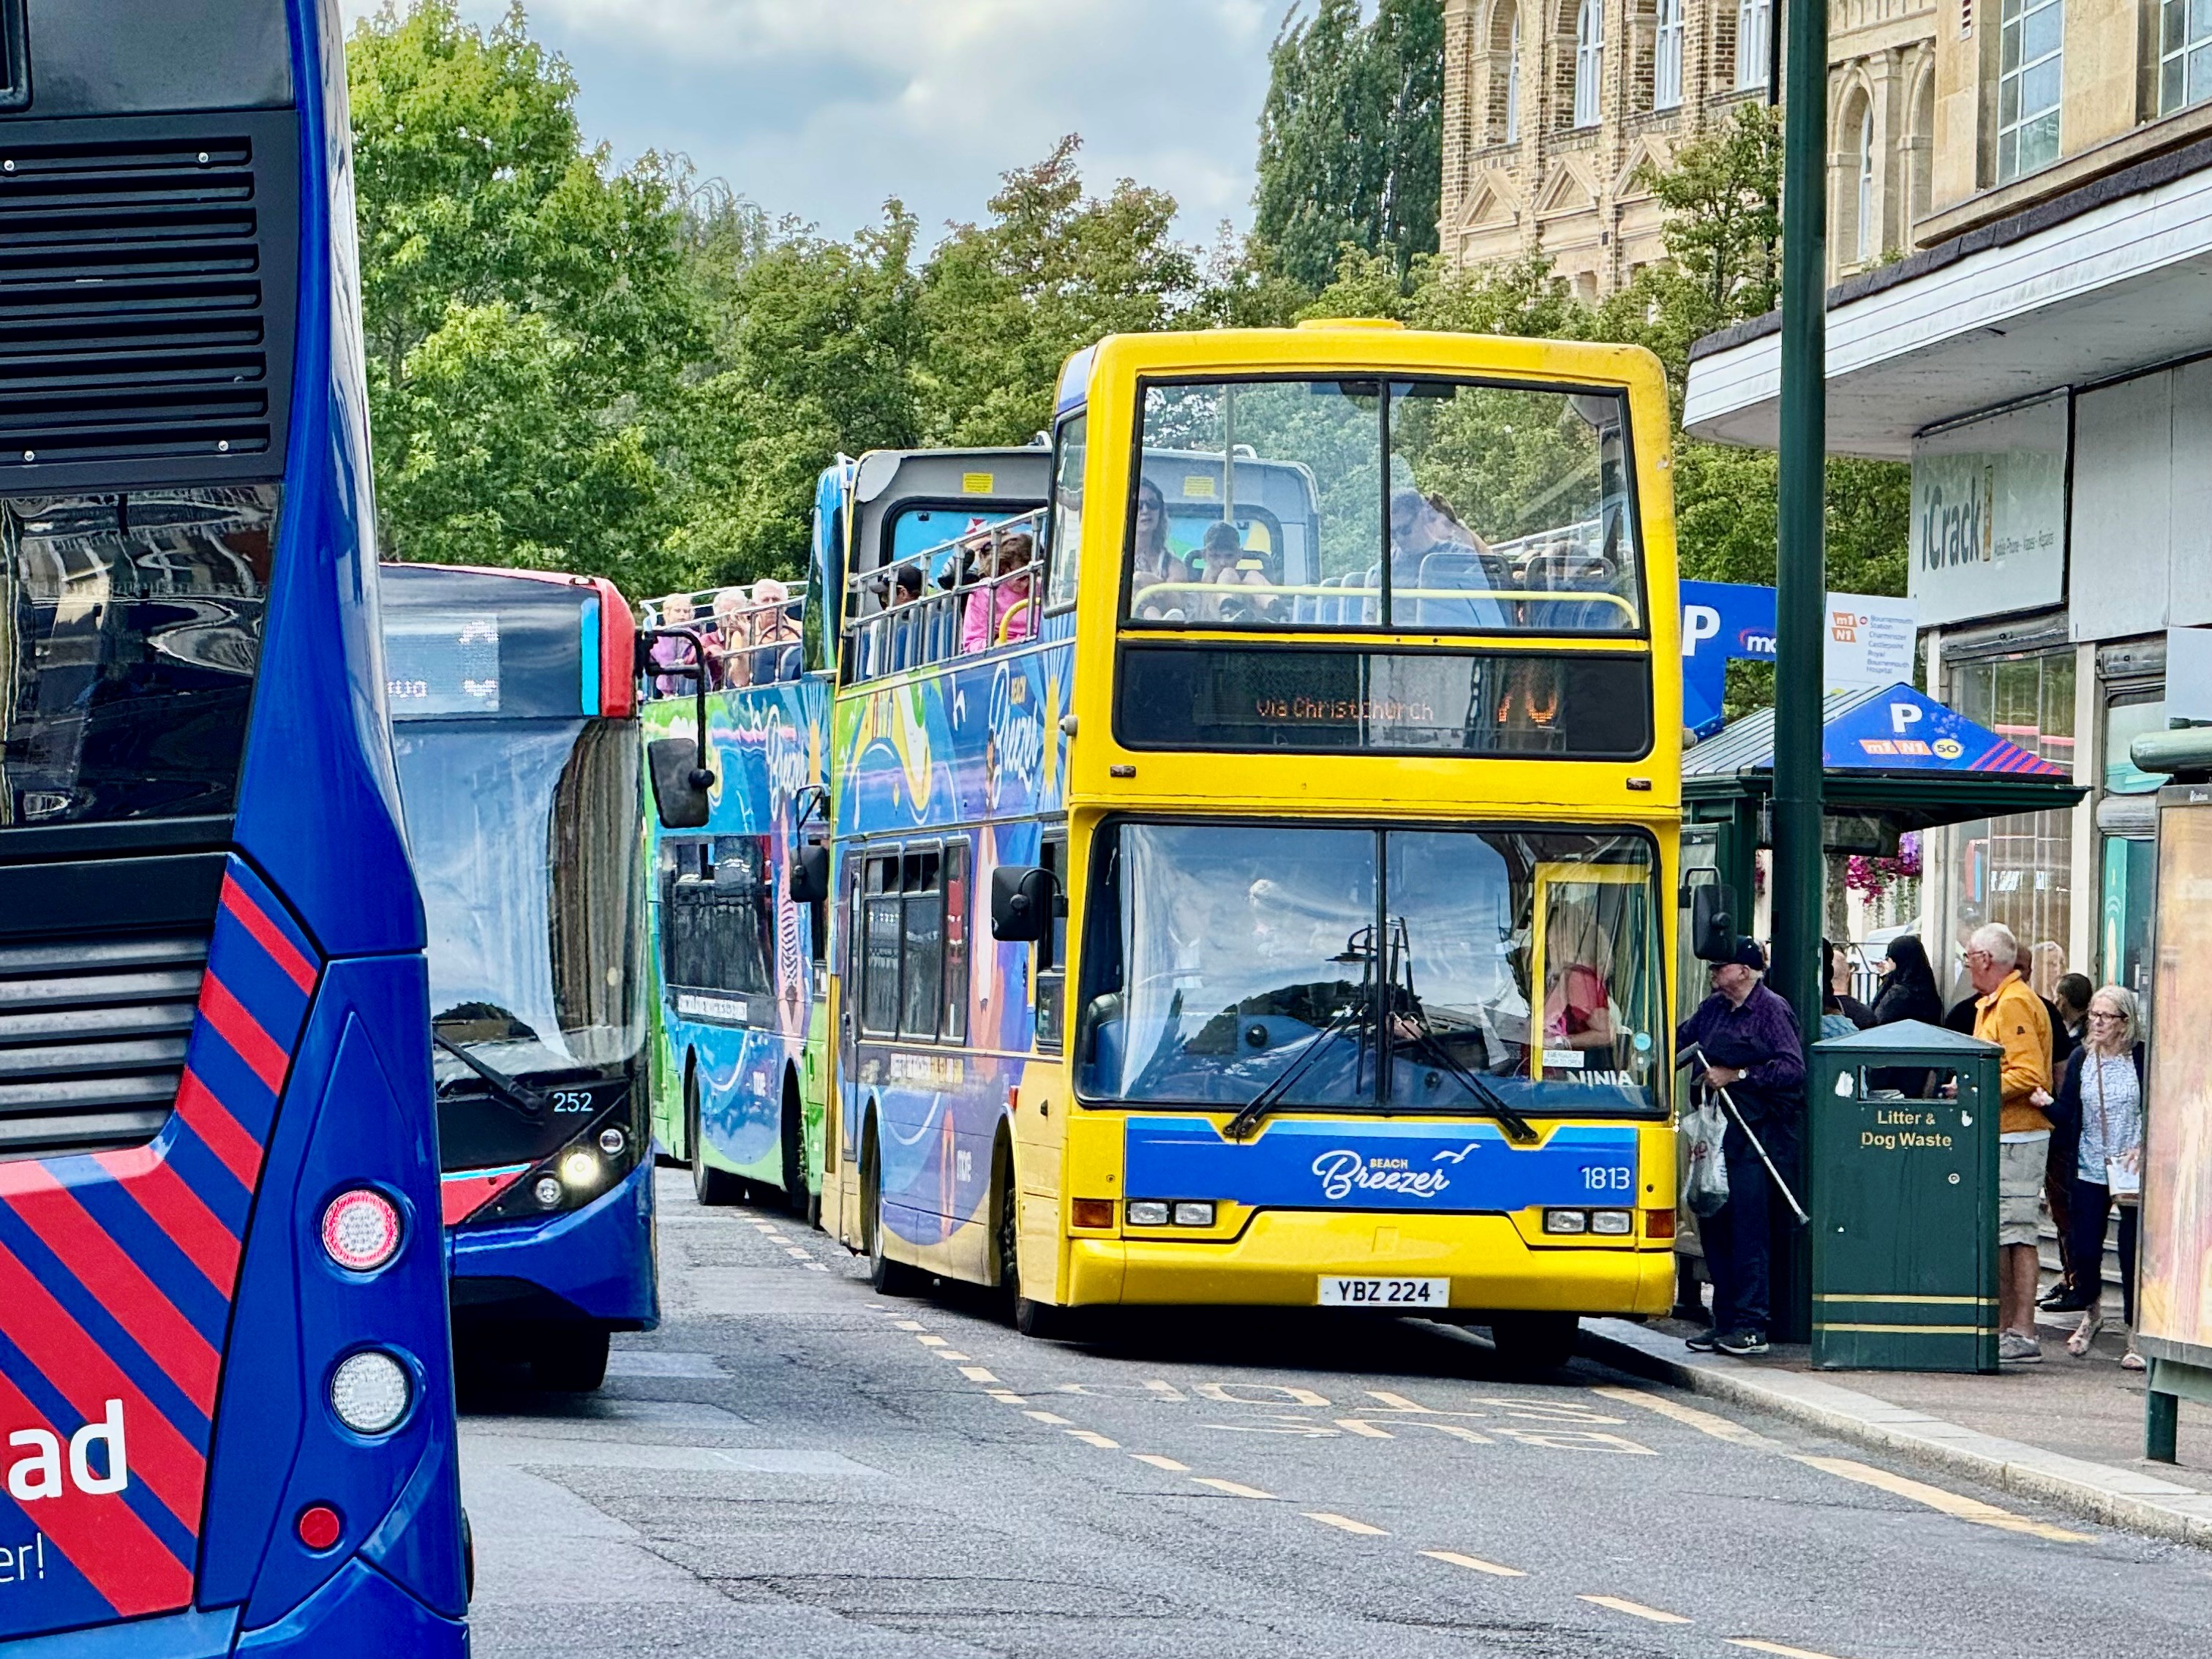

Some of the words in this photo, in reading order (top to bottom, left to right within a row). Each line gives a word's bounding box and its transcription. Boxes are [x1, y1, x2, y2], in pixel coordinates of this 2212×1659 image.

[1922, 476, 1980, 573] iCrack
[1681, 604, 1720, 656] P
[1836, 630, 1851, 640] N1
[1890, 703, 1922, 733] P
[1867, 742, 1891, 752] m1
[1902, 742, 1923, 752] N1
[1937, 745, 1959, 753] 50
[553, 1092, 593, 1112] 252
[1878, 1110, 1922, 1124] Litter
[1925, 1113, 1936, 1125] &
[1862, 1132, 1895, 1150] Dog
[1899, 1132, 1952, 1147] Waste
[1369, 1159, 1408, 1170] BEACH
[1312, 1150, 1451, 1200] Breezer
[1581, 1167, 1630, 1189] 1813
[1338, 1281, 1381, 1302] YBZ
[1388, 1282, 1431, 1302] 224
